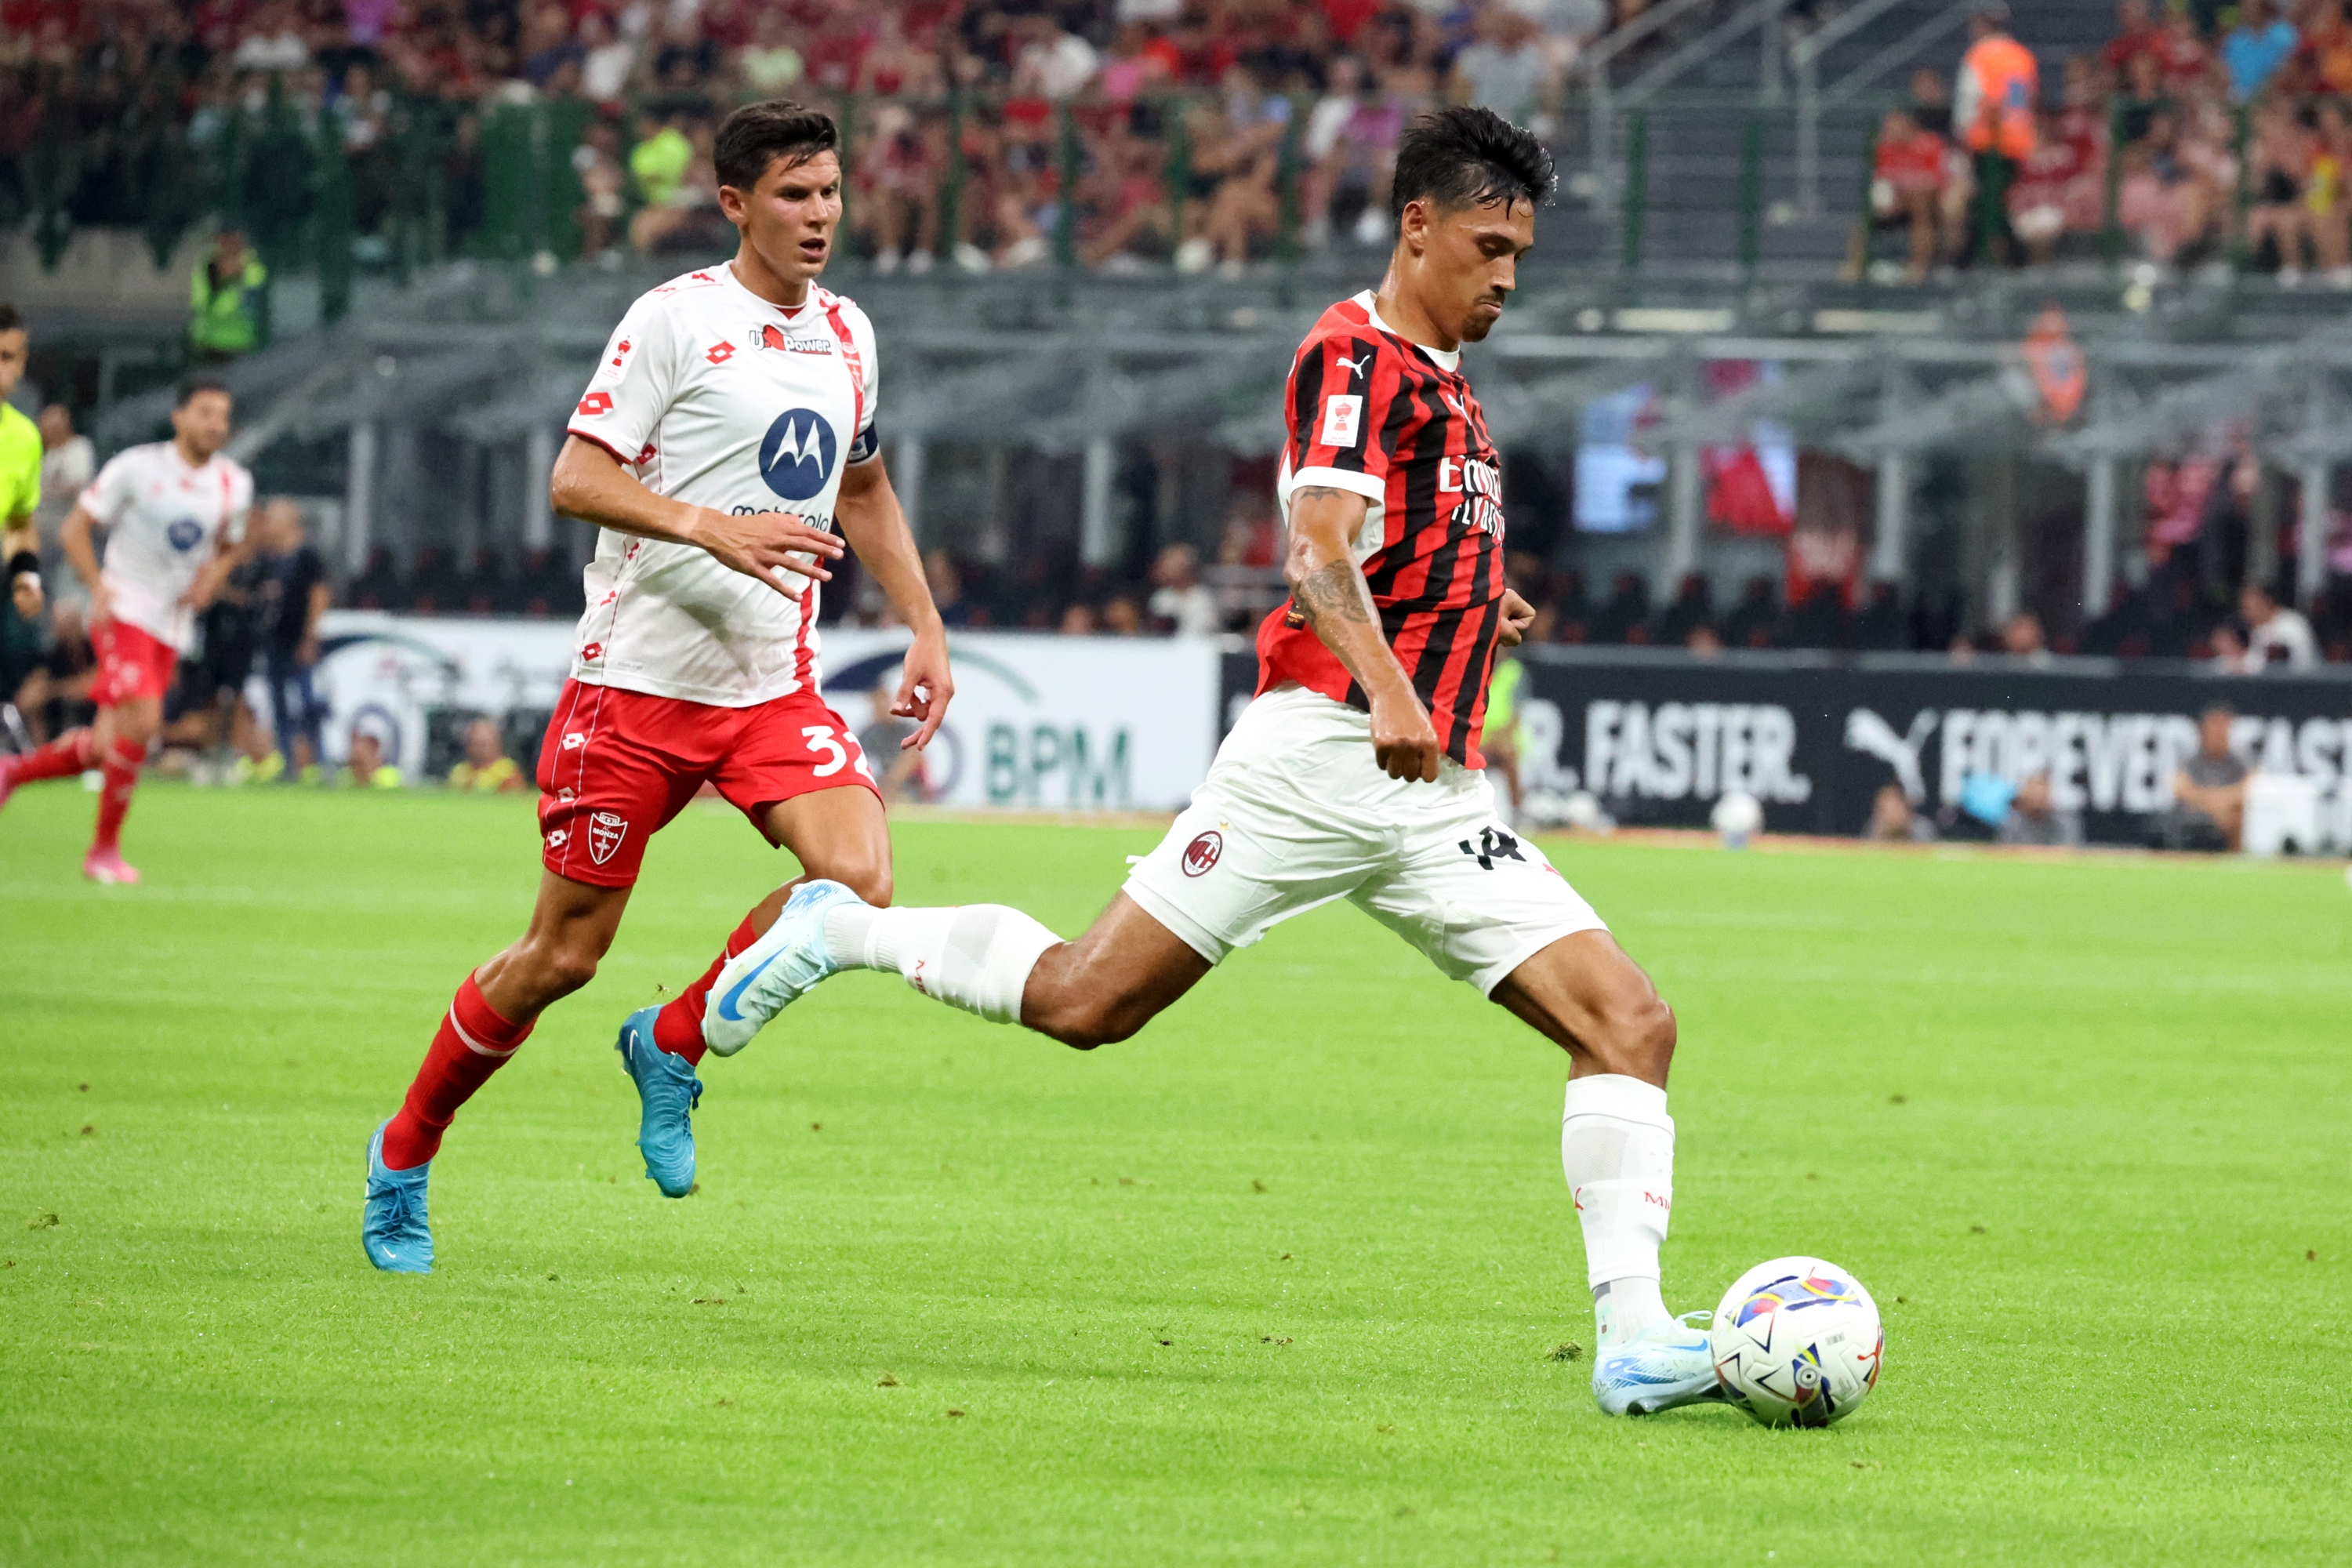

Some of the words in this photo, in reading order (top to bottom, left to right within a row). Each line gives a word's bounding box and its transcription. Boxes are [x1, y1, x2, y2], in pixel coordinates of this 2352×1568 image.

[984, 720, 1131, 808] BPM
[1584, 699, 1812, 804] FASTER.
[593, 827, 619, 839] MONZA
[1185, 862, 1199, 873] 1899
